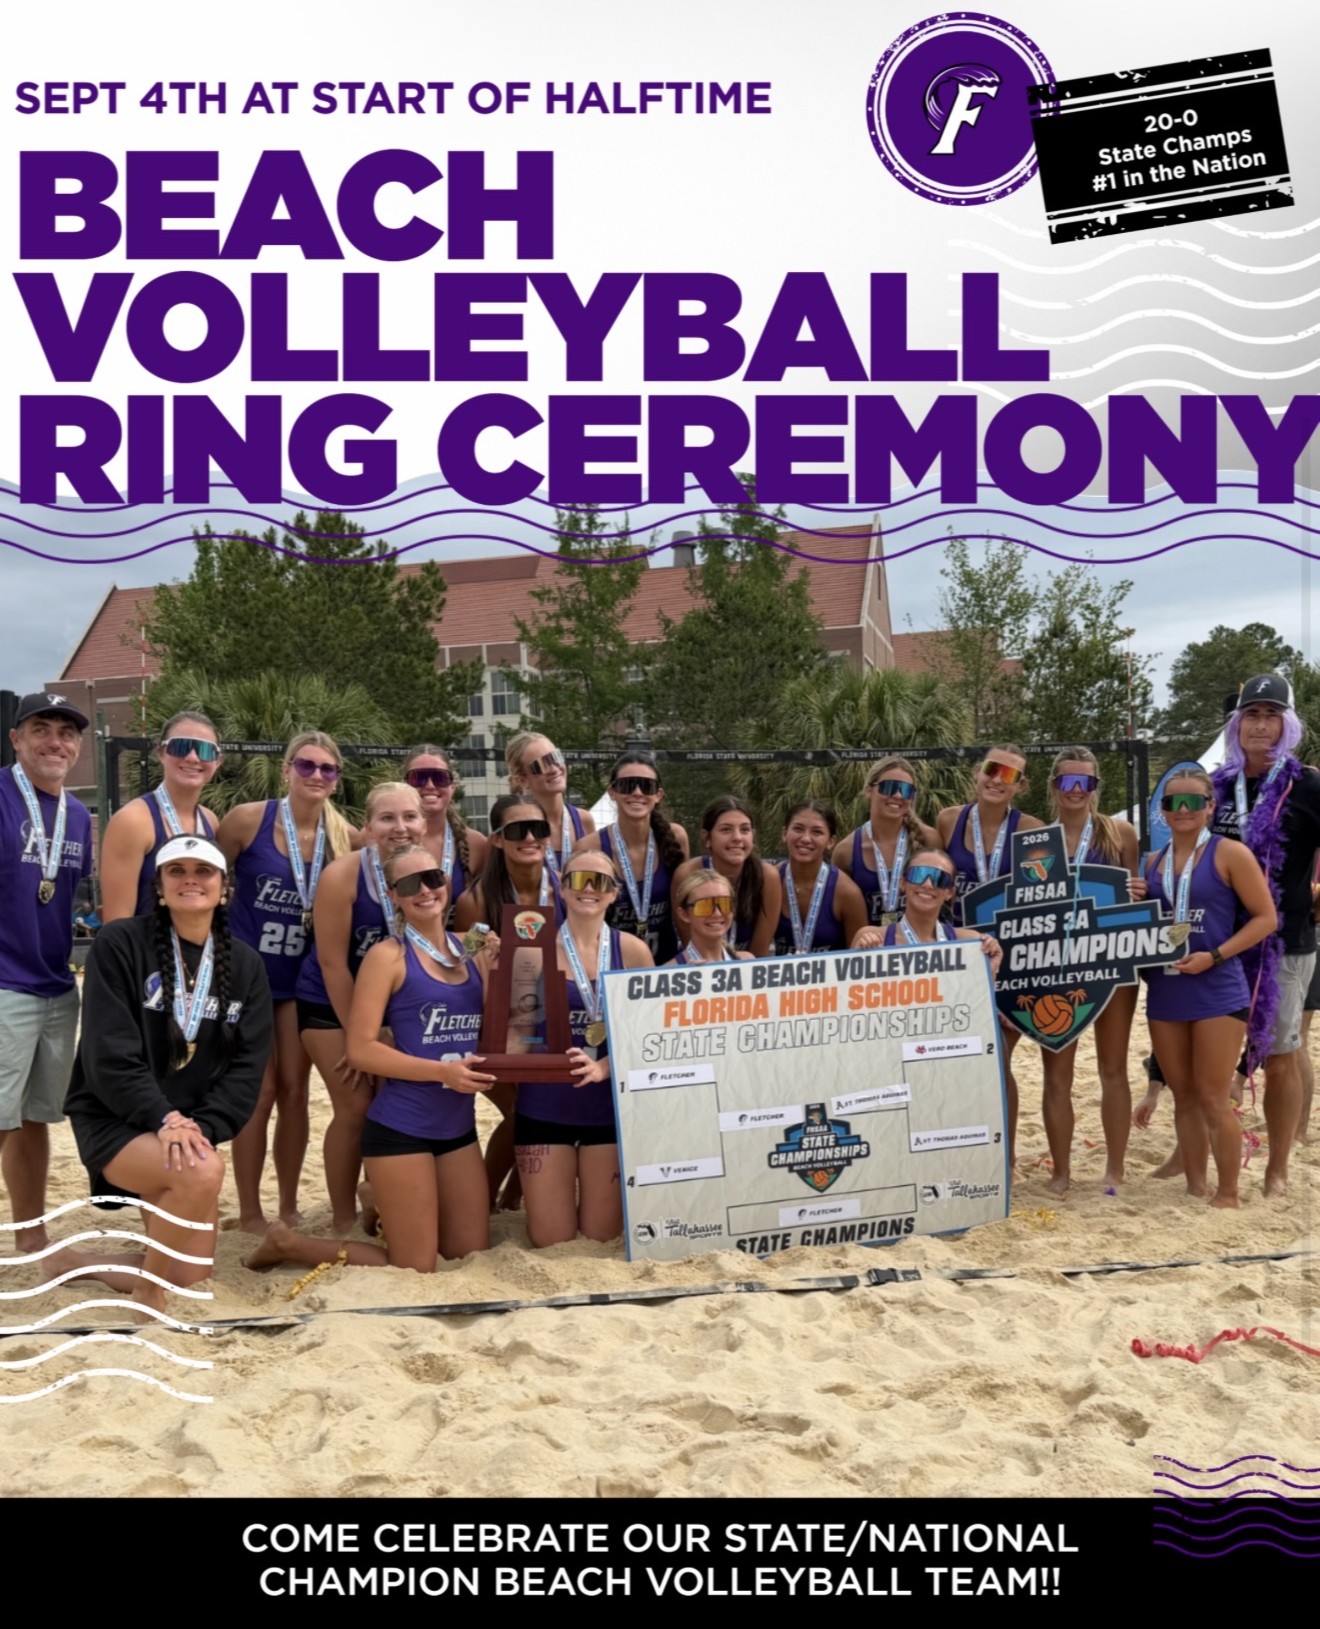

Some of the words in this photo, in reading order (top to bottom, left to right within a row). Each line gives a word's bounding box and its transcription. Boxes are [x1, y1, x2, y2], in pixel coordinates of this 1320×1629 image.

[1022, 833, 1050, 846] 2026
[1014, 881, 1068, 904] FHSAA
[1000, 914, 1058, 940] CLASS
[1063, 909, 1090, 932] 3A
[259, 921, 307, 958] 25
[1009, 926, 1177, 972] CHAMPIONS
[627, 970, 703, 1001] CLASS
[711, 968, 743, 993] 3A
[751, 960, 826, 990] BEACH
[834, 948, 967, 982] VOLLEYBALL
[994, 977, 1029, 992] EACH
[1031, 967, 1121, 987] VOLLEYBALL
[663, 994, 770, 1028] FLORIDA
[779, 986, 838, 1017] HIGH
[848, 977, 944, 1010] SCHOOL
[422, 1034, 452, 1045] BEACH
[642, 1028, 727, 1062] STATE
[737, 1004, 971, 1053] CHAMPIONSHIPS
[986, 1043, 995, 1055] 2
[660, 1071, 696, 1081] FLETCHER
[619, 1081, 626, 1094] 1
[750, 1112, 785, 1122] FLETCHER
[802, 1134, 836, 1149] STATE
[993, 1132, 1002, 1143] 3
[770, 1143, 868, 1166] CHAMPIONSHIPS
[673, 1165, 699, 1174] VENICE
[627, 1176, 636, 1188] 4
[809, 1206, 843, 1217] FLETCHER
[664, 1223, 724, 1238] Tallahassee
[736, 1232, 792, 1254] STATE
[801, 1216, 916, 1247] CHAMPIONS
